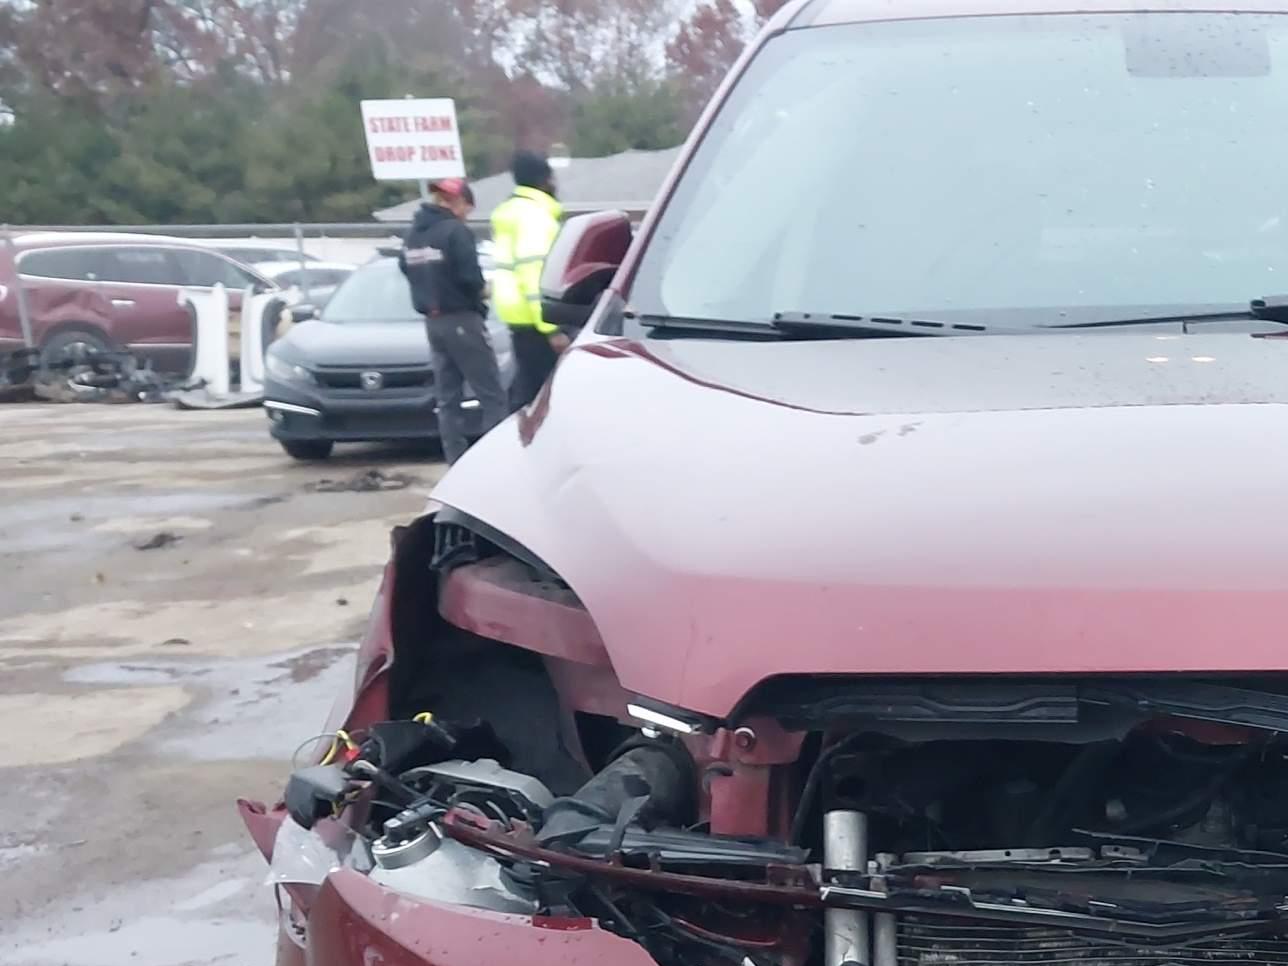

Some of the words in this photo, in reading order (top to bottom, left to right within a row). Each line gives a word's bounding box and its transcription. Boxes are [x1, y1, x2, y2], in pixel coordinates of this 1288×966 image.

[369, 116, 409, 132] STATE
[415, 115, 452, 131] FARM
[374, 146, 416, 161] DROP
[420, 145, 457, 160] ZONE
